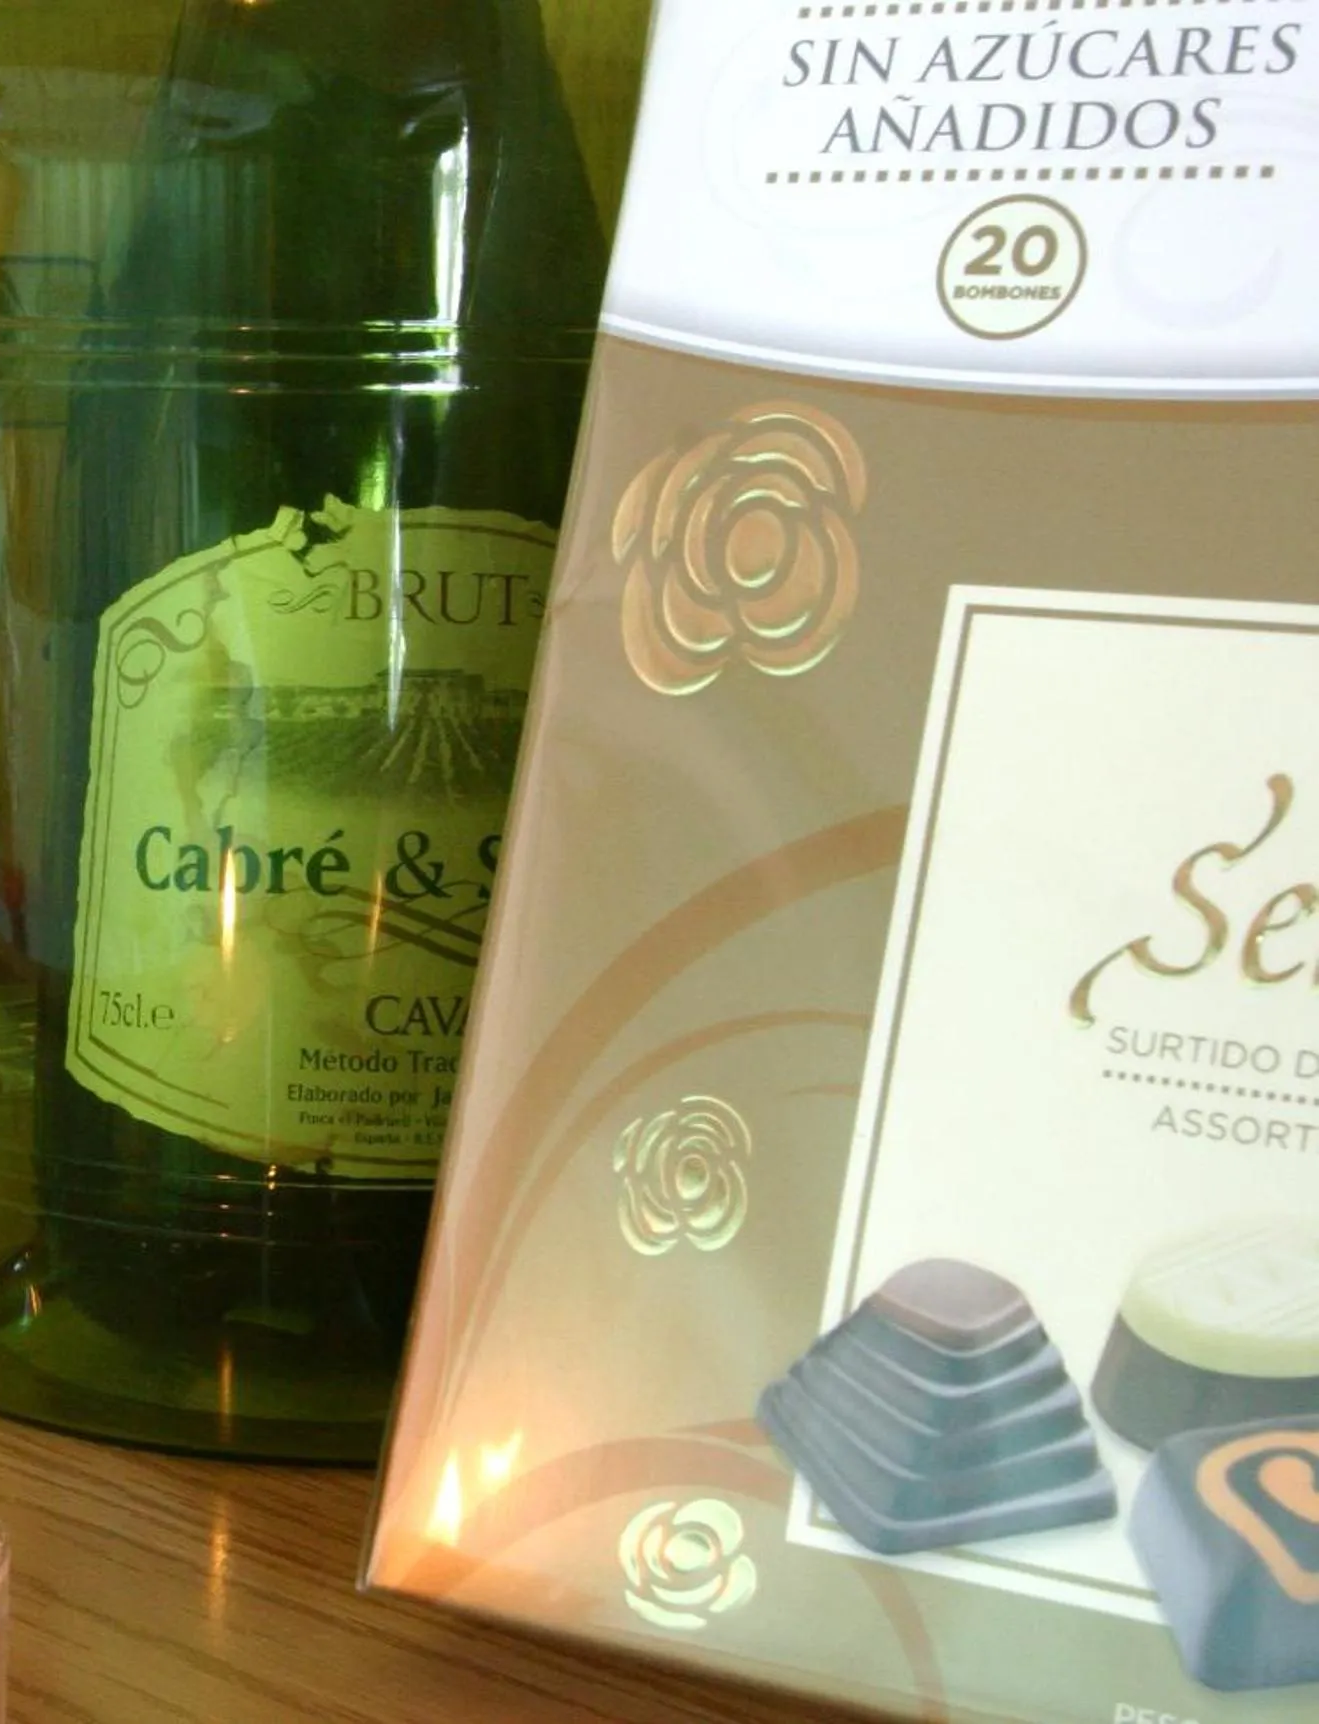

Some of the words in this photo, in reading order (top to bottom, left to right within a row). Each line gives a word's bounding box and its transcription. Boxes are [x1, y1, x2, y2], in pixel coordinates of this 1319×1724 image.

[782, 36, 901, 88] SIN
[917, 20, 1304, 85] AZÚCARES
[819, 95, 1223, 154] AÑADIDOS
[963, 223, 1059, 278] 20
[952, 284, 1063, 301] BOMBONES
[344, 568, 530, 626] BRUT
[135, 825, 351, 896] Cabré
[385, 829, 453, 899] &
[1068, 772, 1319, 1028] Se
[365, 993, 466, 1037] CAV
[1105, 1025, 1282, 1074] SURTIDO
[287, 1083, 383, 1103] Elaborado
[389, 1089, 421, 1107] por
